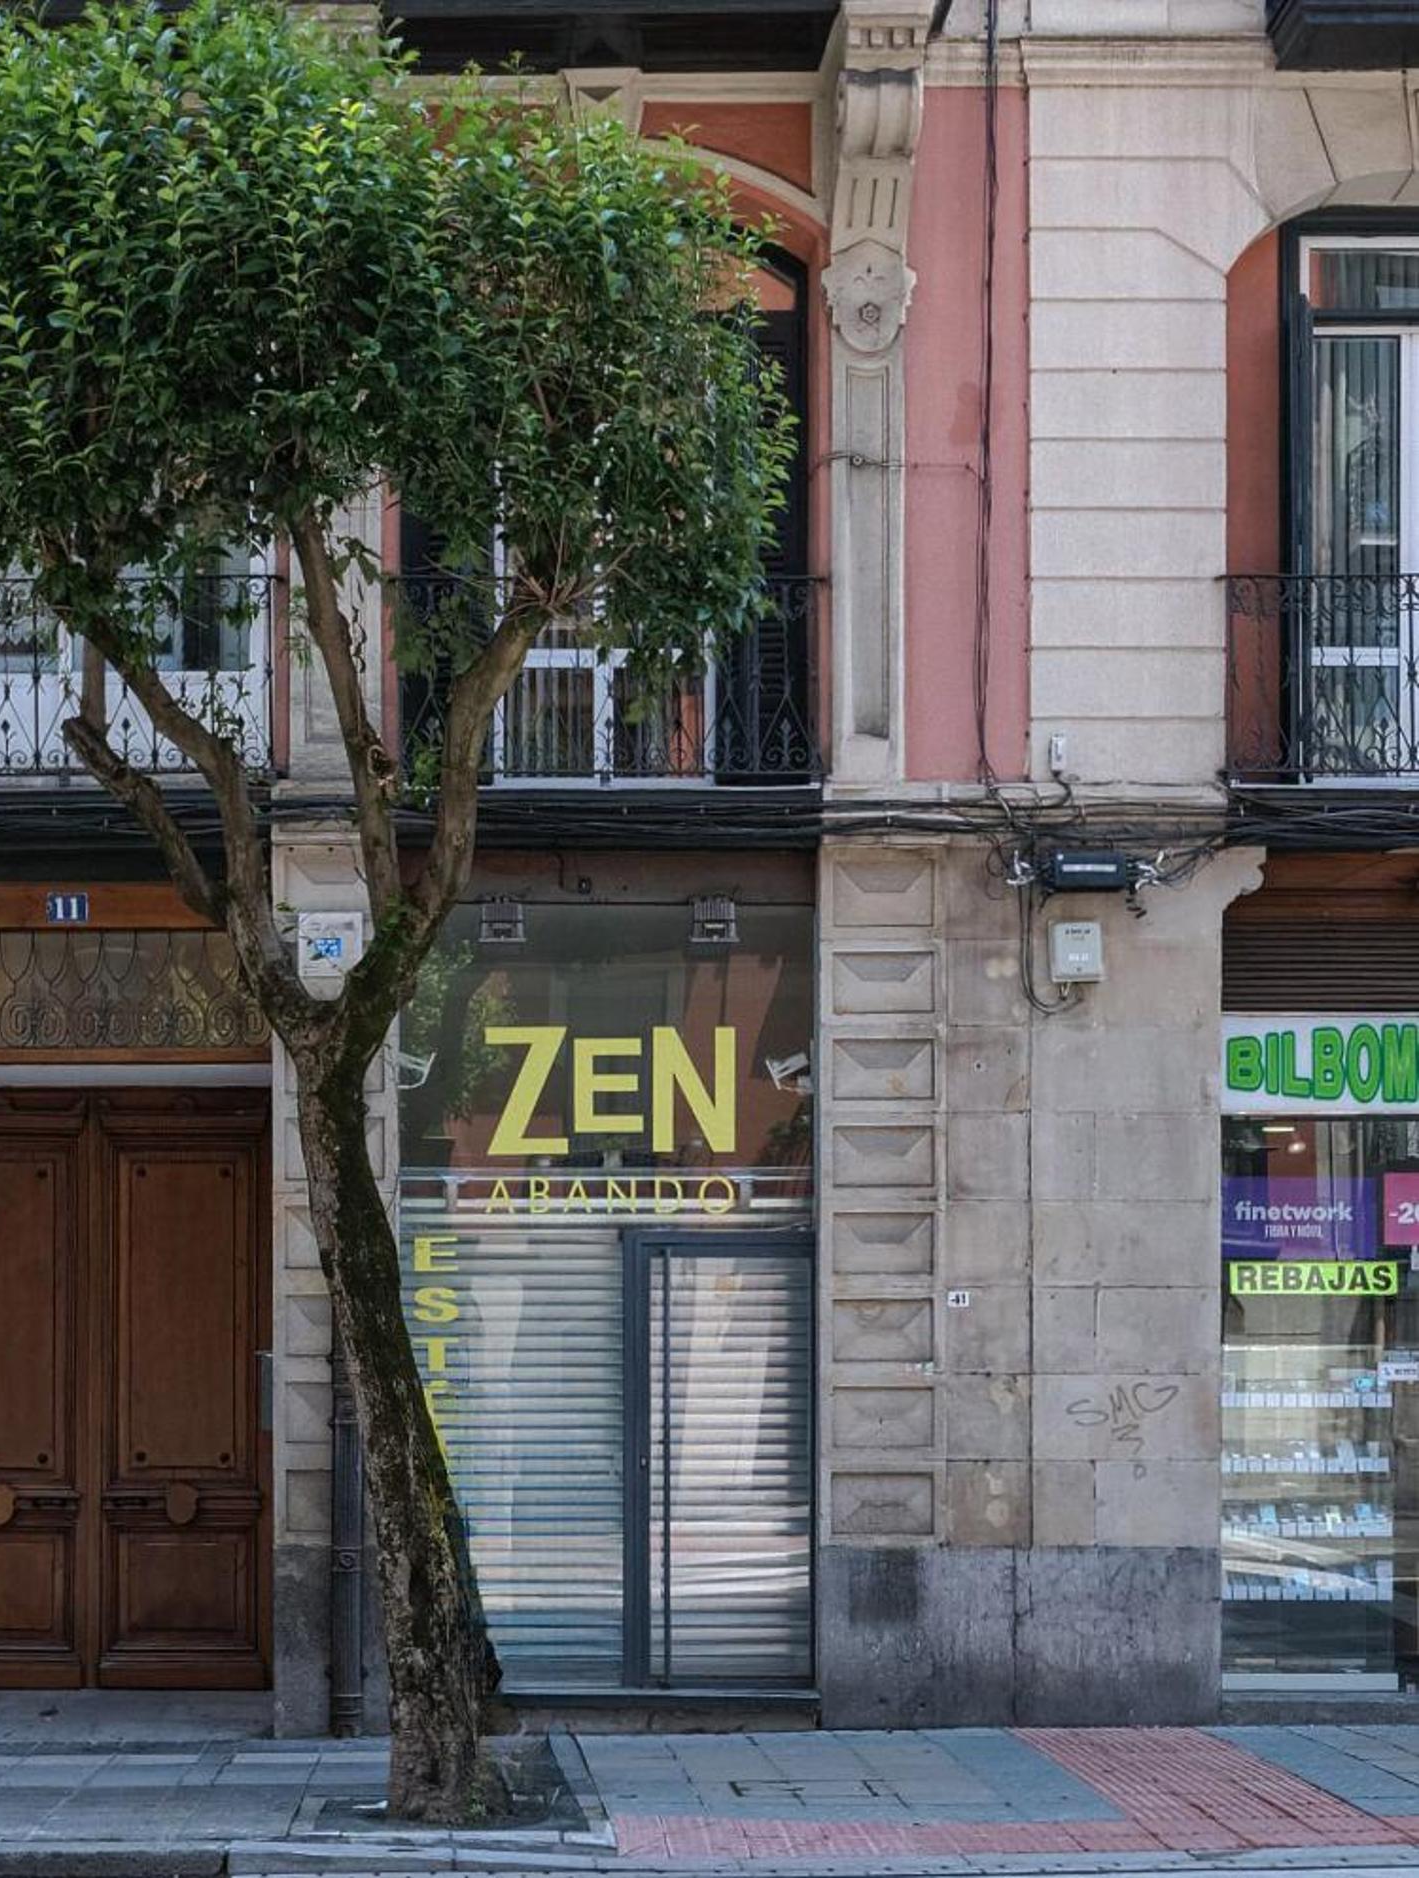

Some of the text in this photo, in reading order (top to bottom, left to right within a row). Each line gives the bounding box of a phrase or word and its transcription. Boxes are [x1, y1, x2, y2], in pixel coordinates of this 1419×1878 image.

[54, 896, 79, 920] 11
[1226, 1022, 1419, 1104] BILBOM
[484, 1026, 737, 1156] ZEN
[485, 1175, 736, 1214] ABANDO
[1234, 1201, 1353, 1222] finetwork
[1237, 1264, 1392, 1292] REBAJAS
